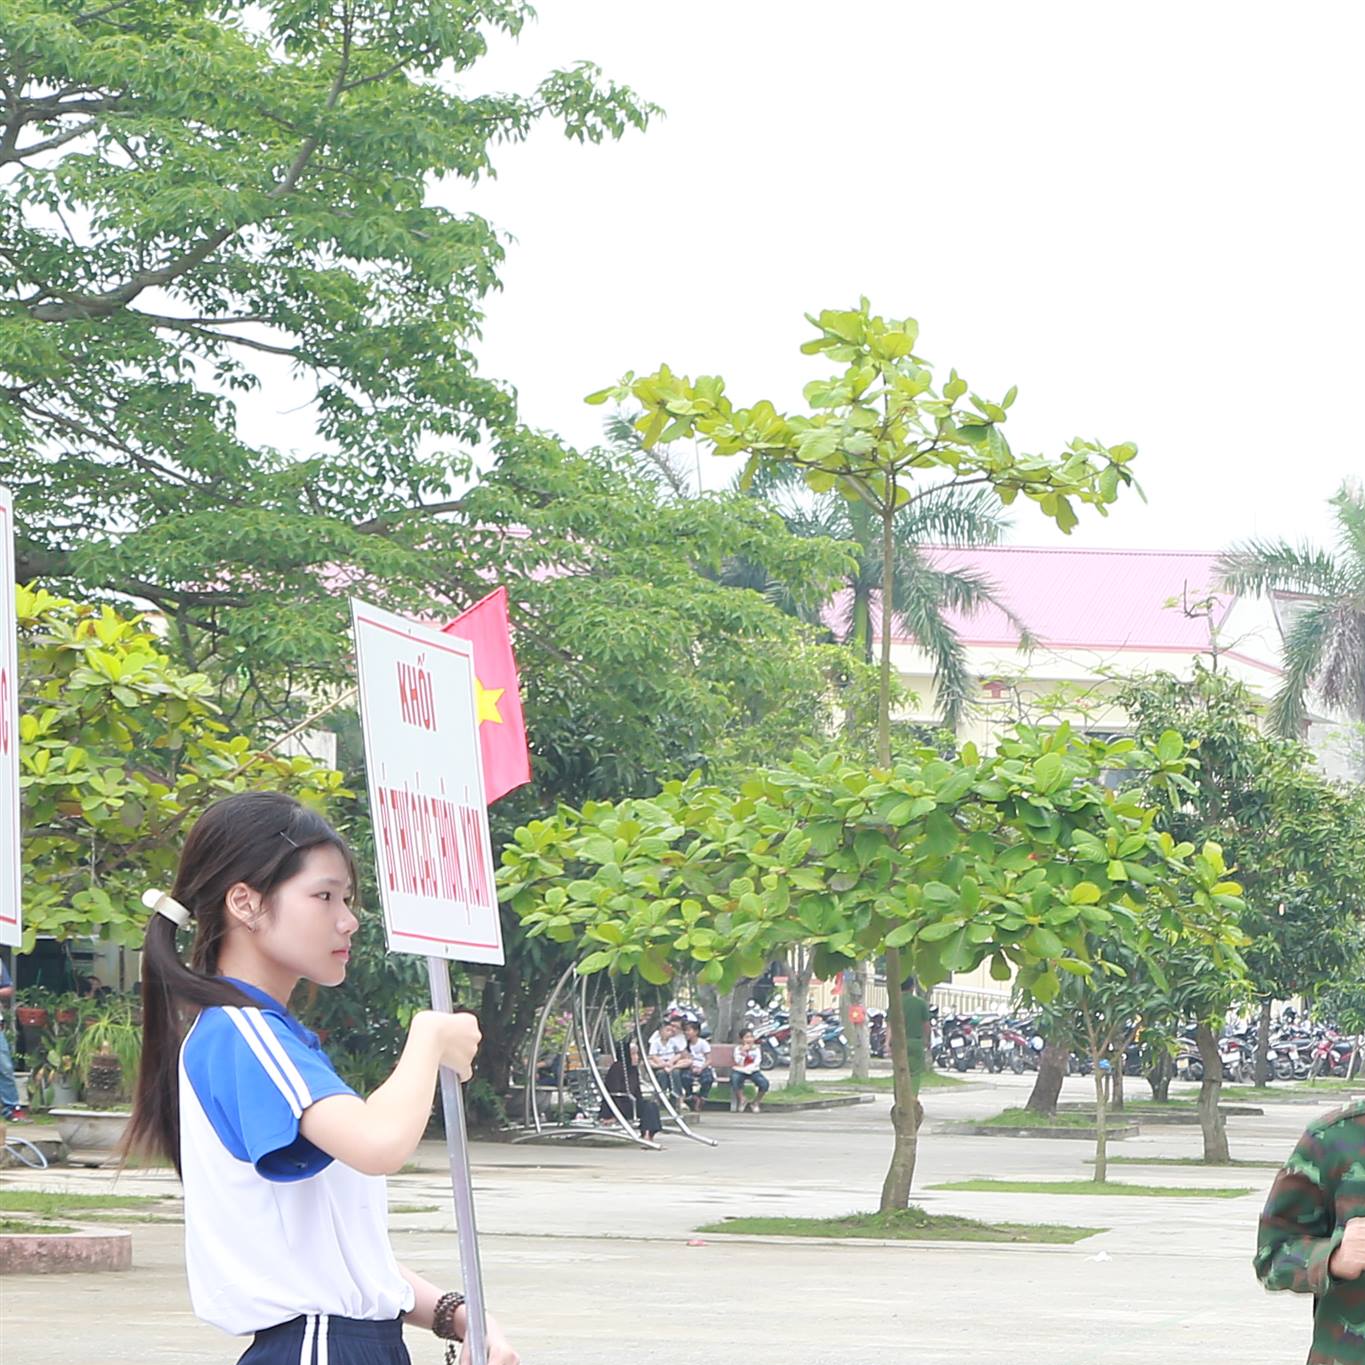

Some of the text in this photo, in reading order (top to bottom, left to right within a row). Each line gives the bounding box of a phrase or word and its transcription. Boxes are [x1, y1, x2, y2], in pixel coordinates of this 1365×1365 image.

[396, 652, 437, 732] KHỐI
[378, 762, 400, 893] BÍ
[390, 780, 418, 896] THƯ
[411, 771, 439, 899] CÁC
[459, 785, 490, 908] XÓM
